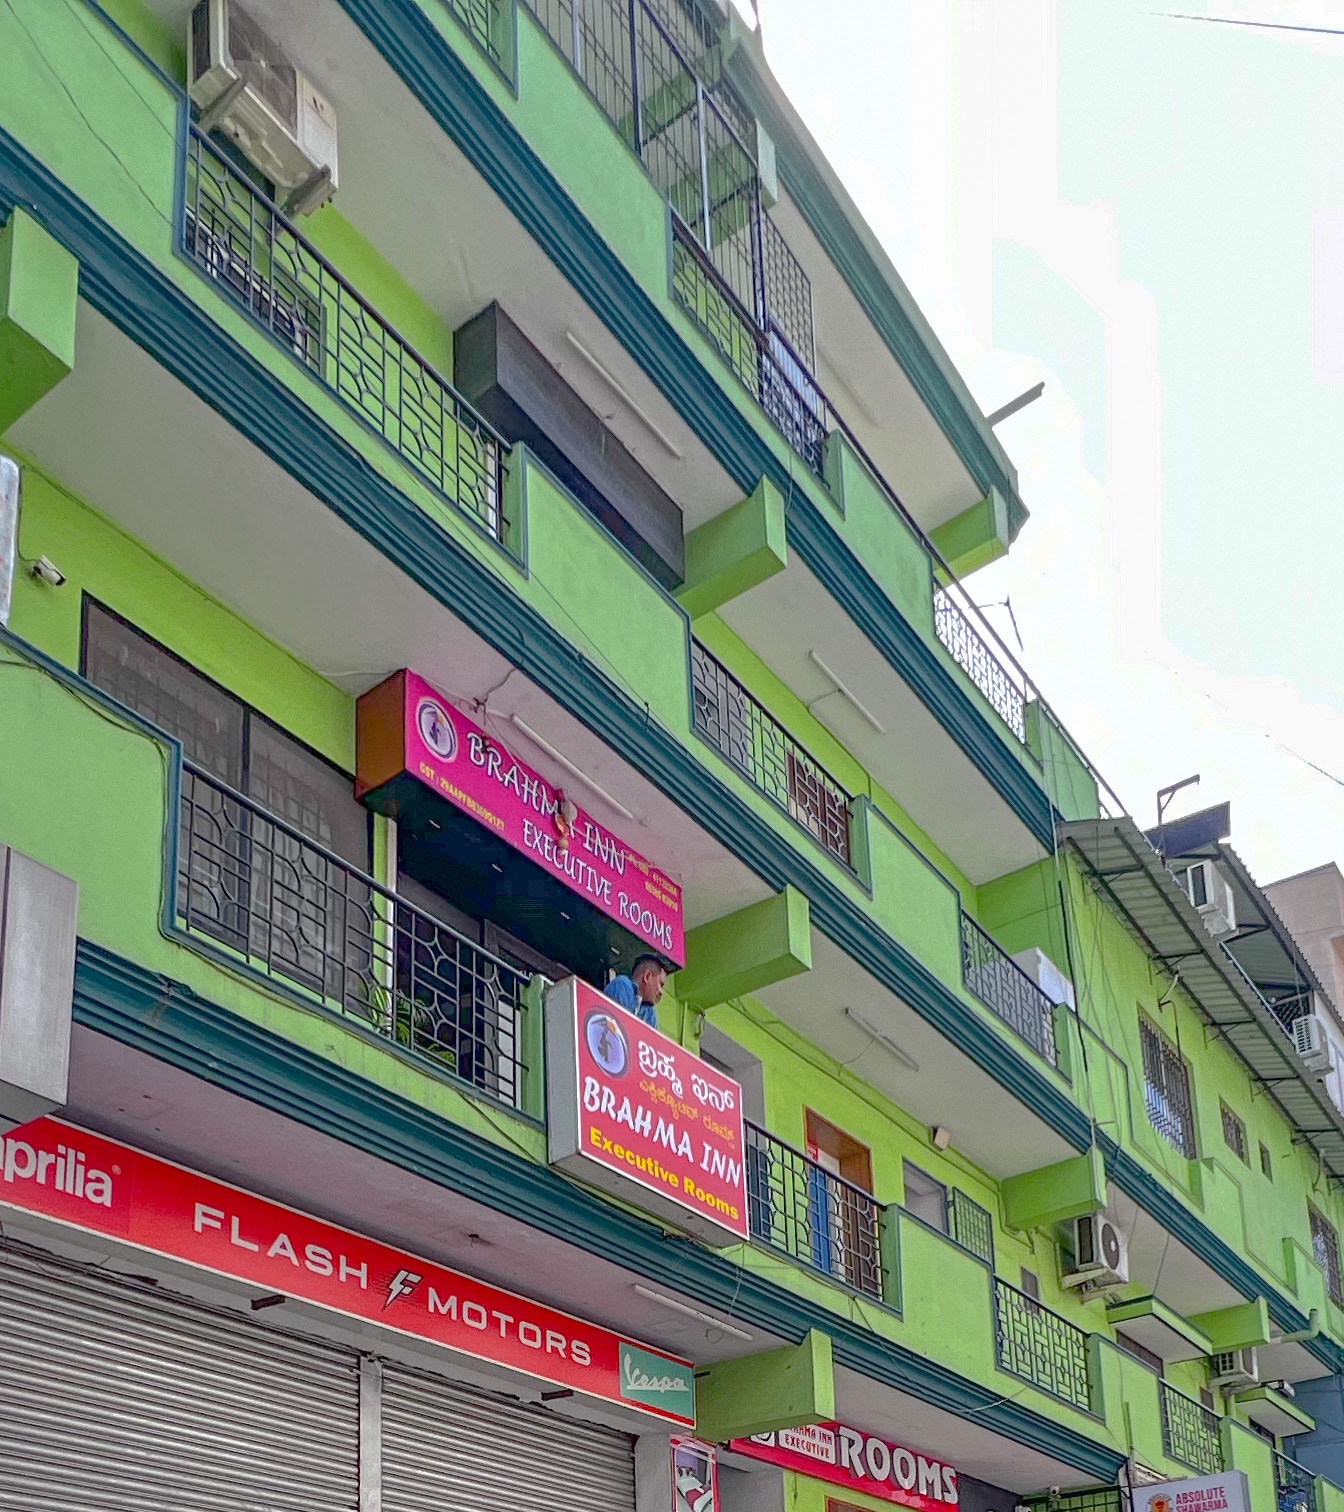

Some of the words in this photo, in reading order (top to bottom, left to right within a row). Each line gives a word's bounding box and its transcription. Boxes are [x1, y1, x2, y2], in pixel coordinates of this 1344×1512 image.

[466, 731, 575, 839] BRAHM
[582, 820, 627, 876] INN
[522, 817, 612, 906] EXECUTIVE
[617, 891, 674, 951] ROOMS
[583, 1076, 695, 1164] BRAHMA
[699, 1140, 742, 1189] INN
[589, 1126, 680, 1189] Executive
[683, 1175, 740, 1221] Rooms
[193, 1201, 369, 1291] FLASH
[427, 1286, 592, 1367] MOTORS
[623, 1350, 691, 1394] Vespa
[784, 1433, 830, 1459] EXECUTIVE
[838, 1425, 959, 1505] ROOMS
[1175, 1486, 1226, 1505] ABSOLUTE
